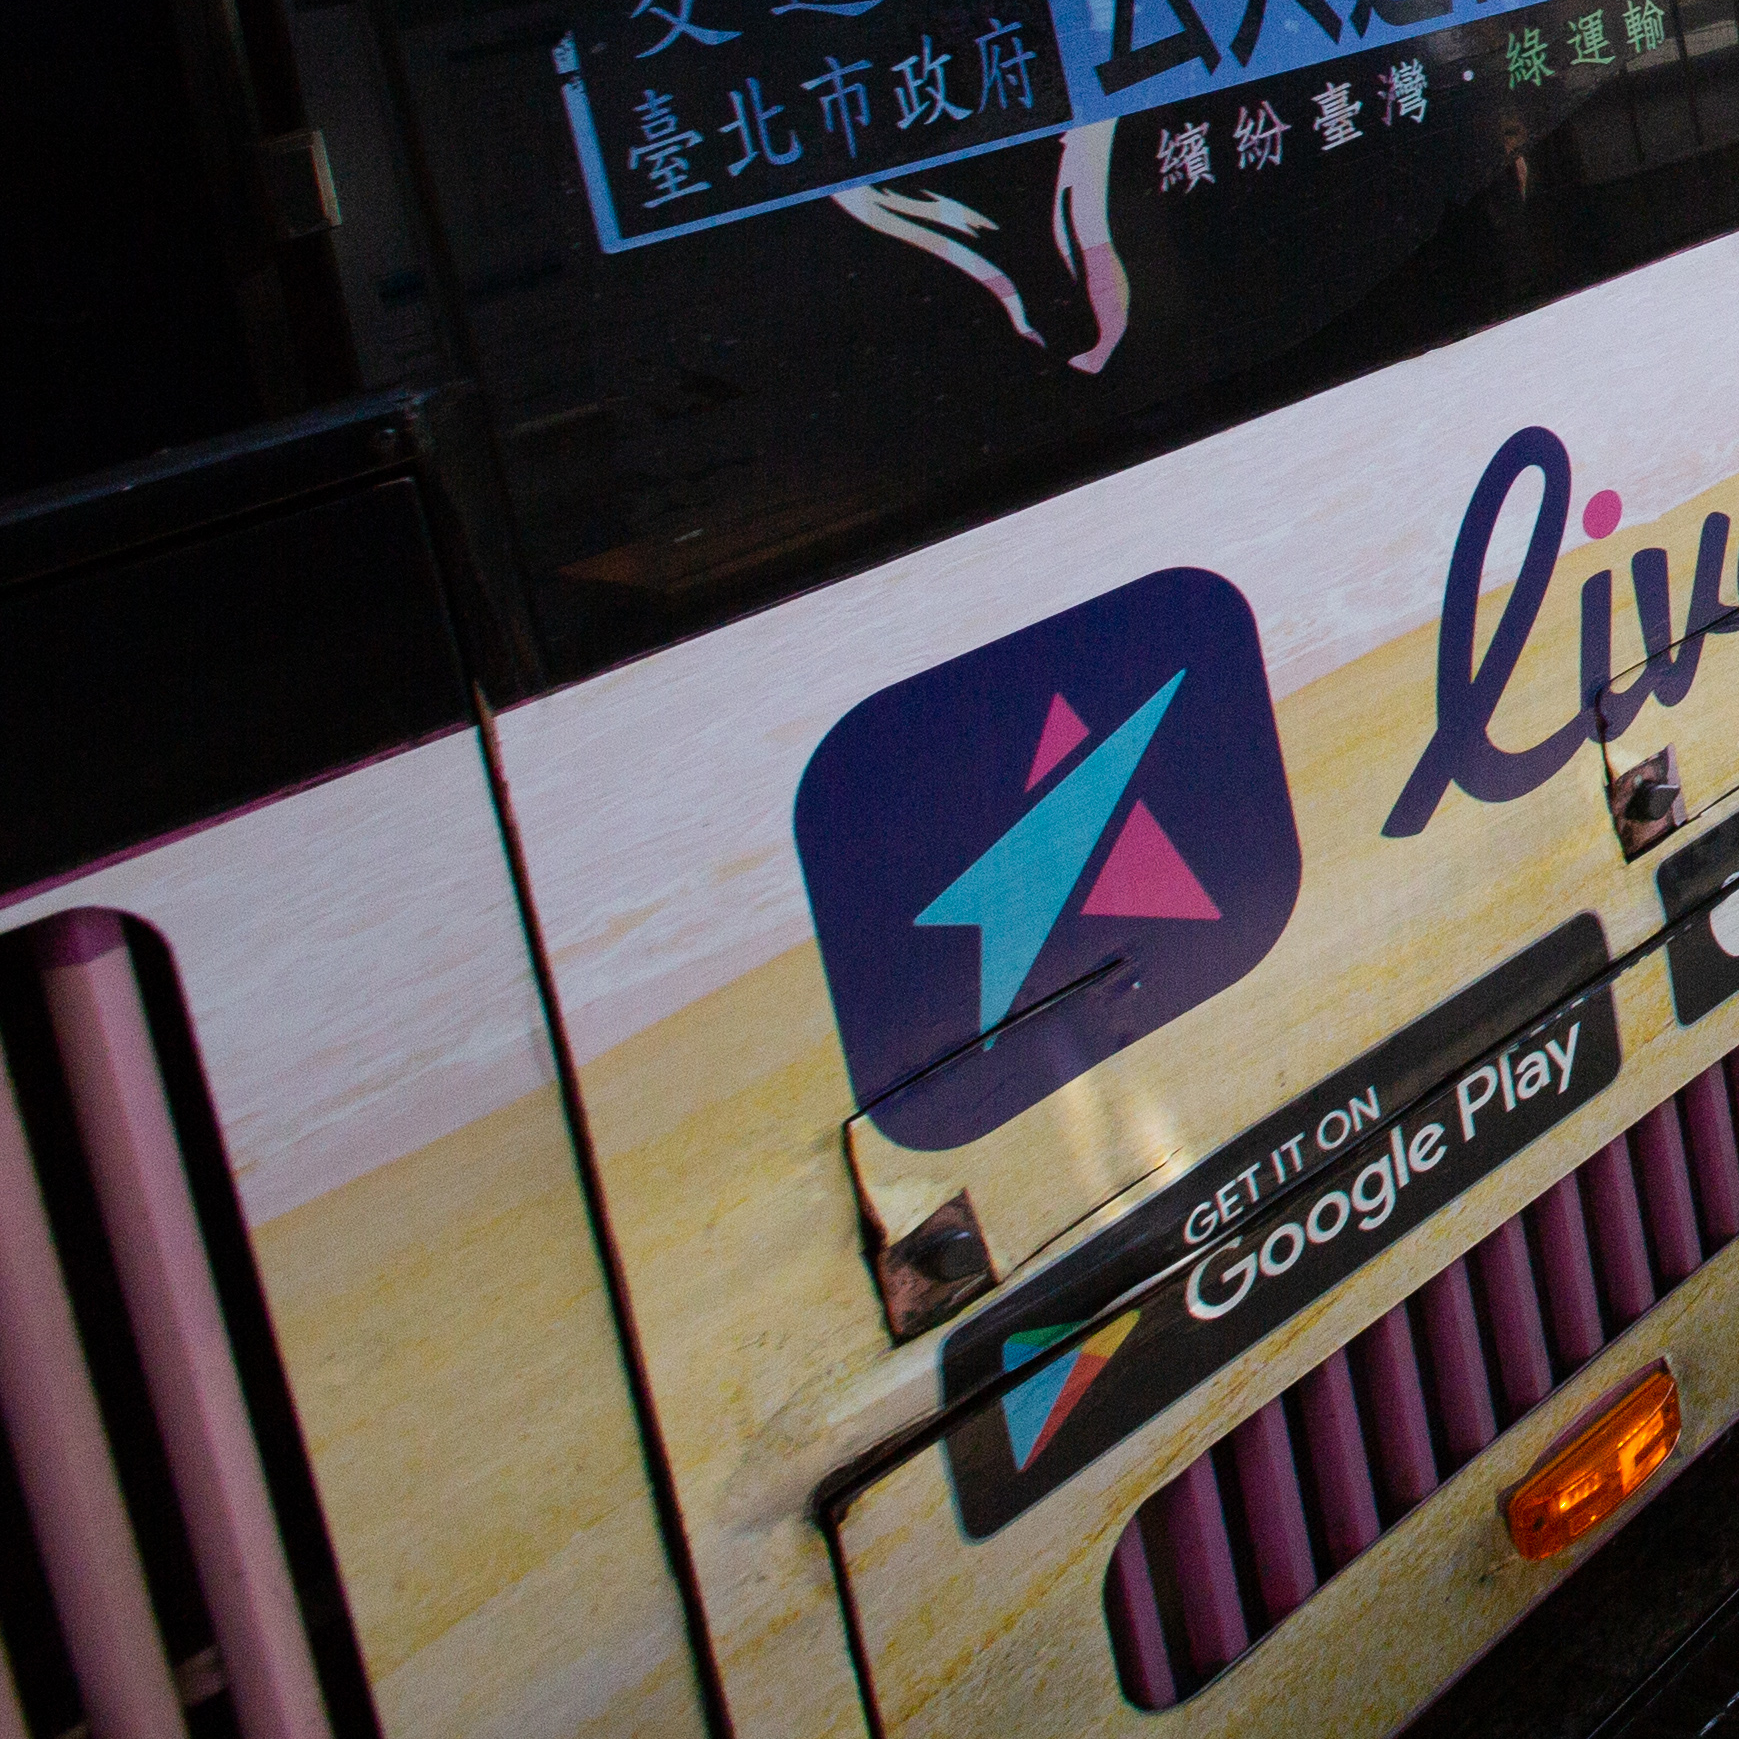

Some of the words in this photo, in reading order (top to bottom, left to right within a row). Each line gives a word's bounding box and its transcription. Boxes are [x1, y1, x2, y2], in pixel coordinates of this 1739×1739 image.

[627, 14, 1038, 215] 臺北市政府
[1183, 1163, 1261, 1245] GET
[1270, 1132, 1307, 1184] IT
[1316, 1085, 1381, 1151] ON
[1185, 1122, 1448, 1321] Google
[1457, 1021, 1581, 1143] Play
